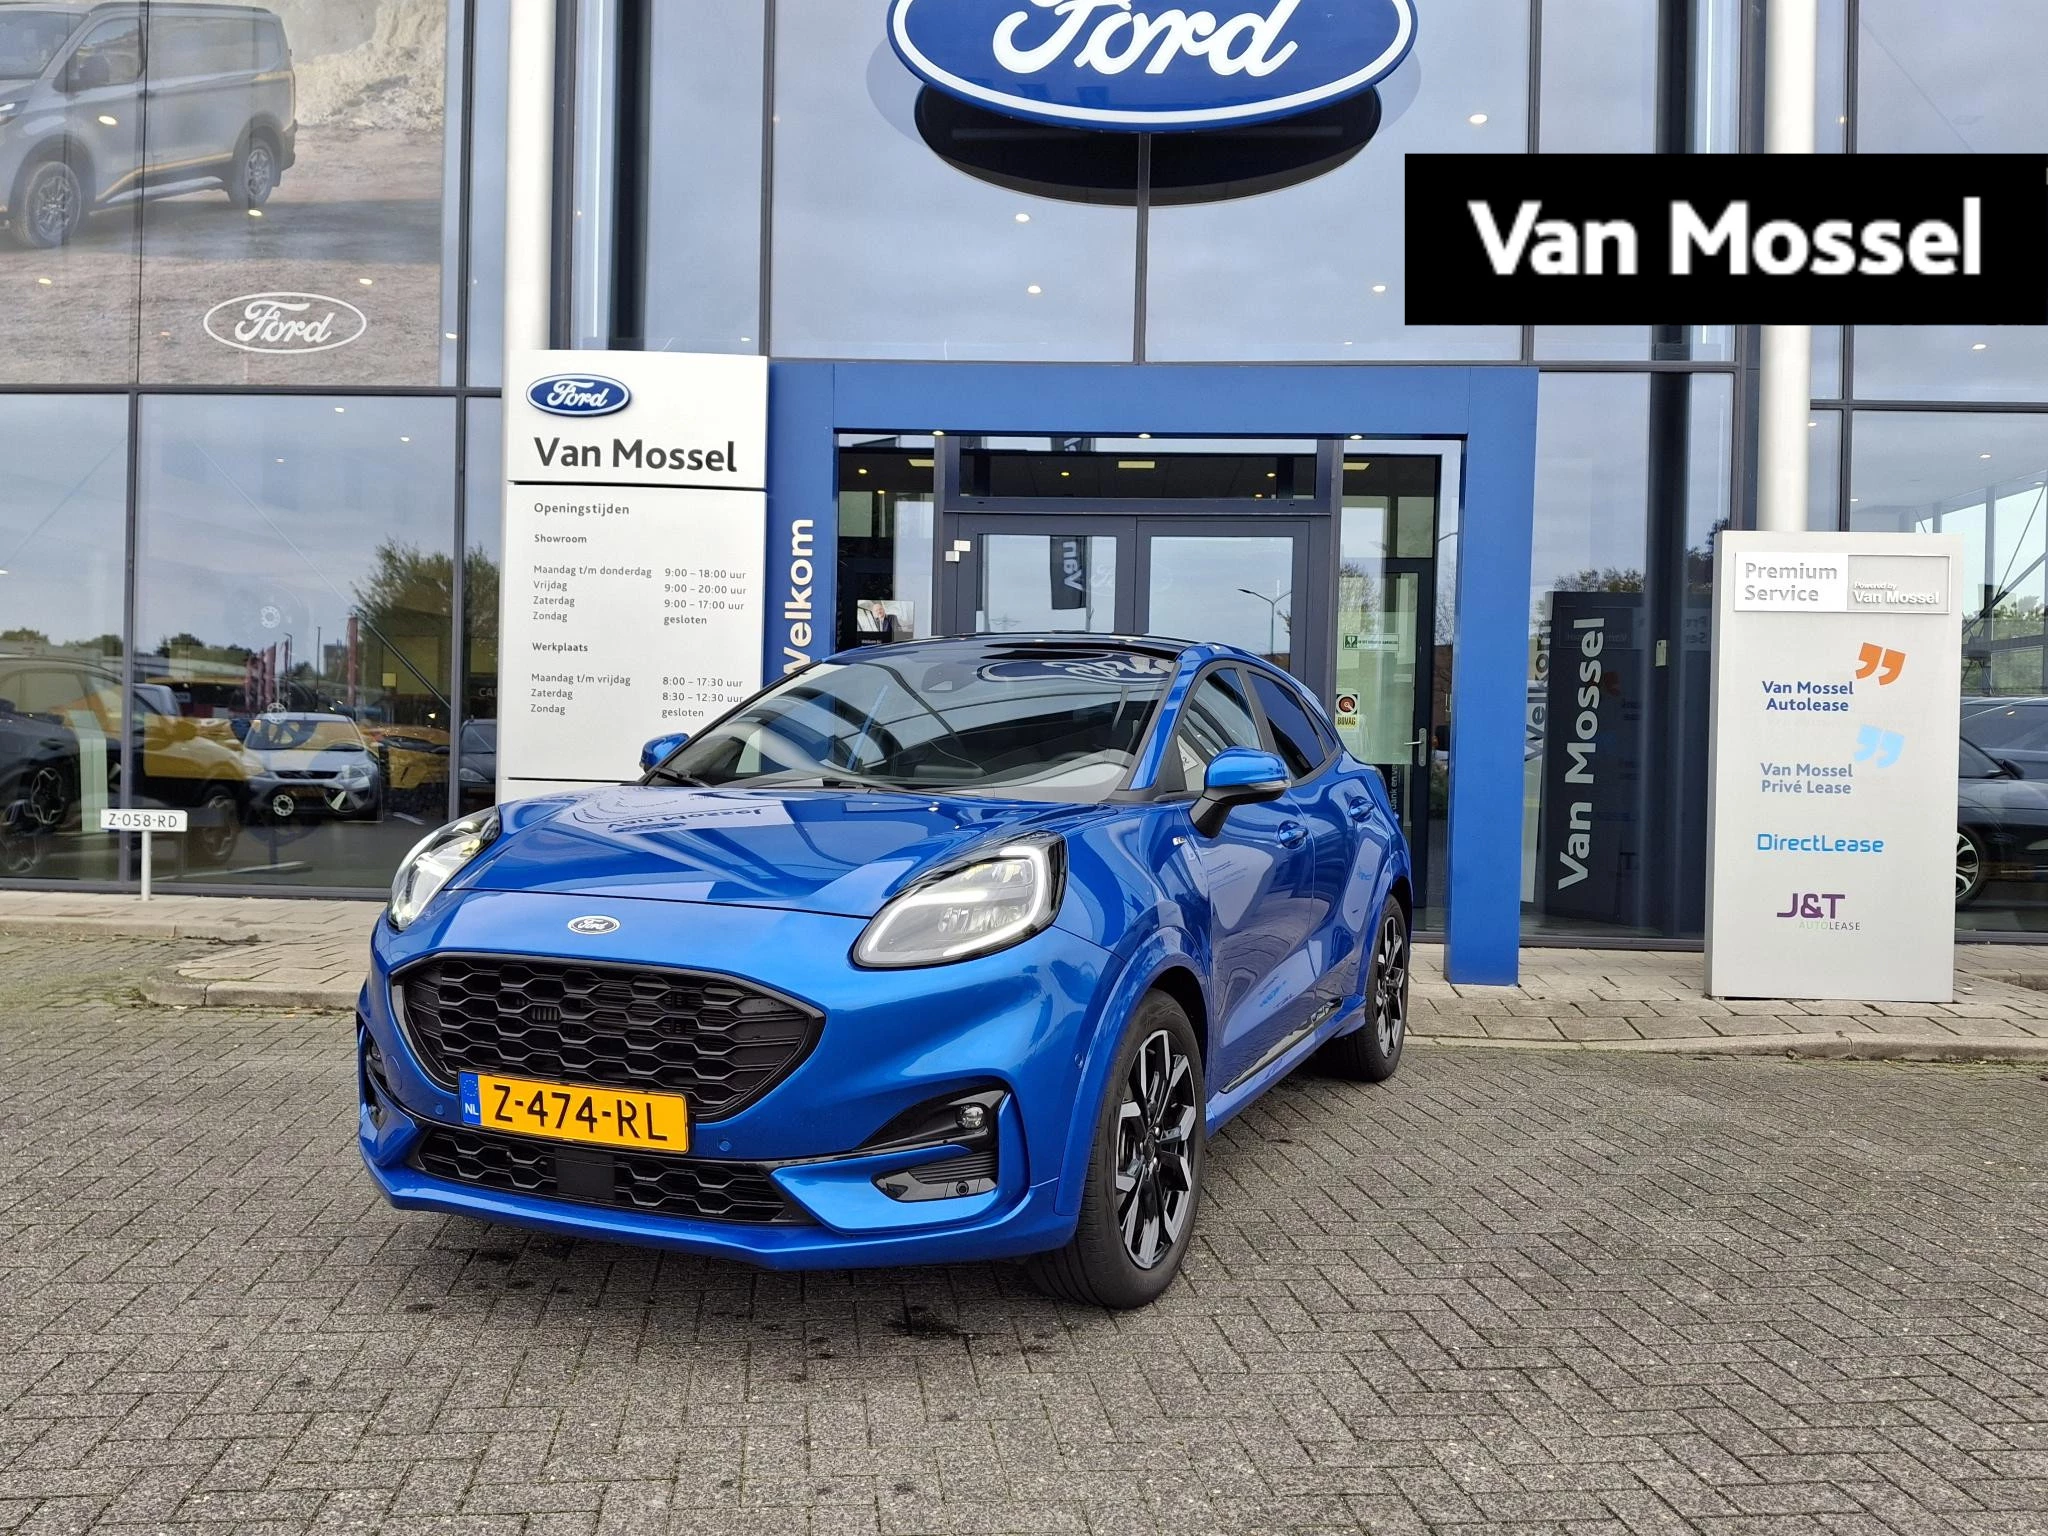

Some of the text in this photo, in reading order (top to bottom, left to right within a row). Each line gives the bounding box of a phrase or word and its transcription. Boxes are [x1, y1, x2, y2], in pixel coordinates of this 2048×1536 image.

[992, 0, 1299, 77] Ford
[235, 300, 335, 343] Ford
[547, 379, 610, 407] Ford
[534, 437, 738, 473] Van Mossel
[533, 502, 630, 517] Openingstijden
[534, 533, 588, 544] Showroom
[533, 564, 577, 577] Maandag
[579, 565, 597, 575] t/m
[599, 566, 652, 579] donderdag
[664, 568, 688, 578] 9:00
[699, 569, 727, 579] 18:00
[729, 571, 747, 580] uur
[1745, 562, 1838, 580] Premium
[533, 580, 568, 592] Vrijdag
[664, 583, 688, 593] 9:00
[698, 584, 728, 594] 20:00
[730, 586, 747, 595] uur
[1744, 585, 1819, 602] Service
[532, 595, 576, 608] Zaterdag
[664, 599, 687, 609] 9:00
[698, 600, 725, 610] 17:00
[728, 603, 745, 611] uur
[1854, 590, 1940, 605] Van Mossel
[532, 611, 708, 626] Zondag gesloten
[532, 642, 589, 653] Werkplaats
[531, 673, 574, 685] Maandag
[577, 673, 595, 684] t/m
[597, 675, 631, 687] vrijdag
[662, 676, 686, 686] 8:00
[697, 677, 724, 687] 17:30
[530, 688, 574, 700] Zaterdag
[662, 691, 685, 701] 8:30
[695, 692, 724, 703] 12:30
[727, 695, 743, 703] uur
[1762, 681, 1854, 695] Van Mossel
[1565, 617, 1605, 784] Mossel
[1766, 697, 1849, 711] Autolease
[530, 703, 704, 718] Zondag gesloten
[1760, 763, 1853, 777] Van Mossel
[1761, 779, 1852, 794] Privé Lease
[108, 812, 178, 828] Z-058-RD
[1558, 802, 1593, 890] Van
[1757, 833, 1885, 853] DirectLease
[1776, 893, 1846, 919] J&T
[464, 1102, 480, 1117] NL
[493, 1084, 668, 1142] Z-474-RL
